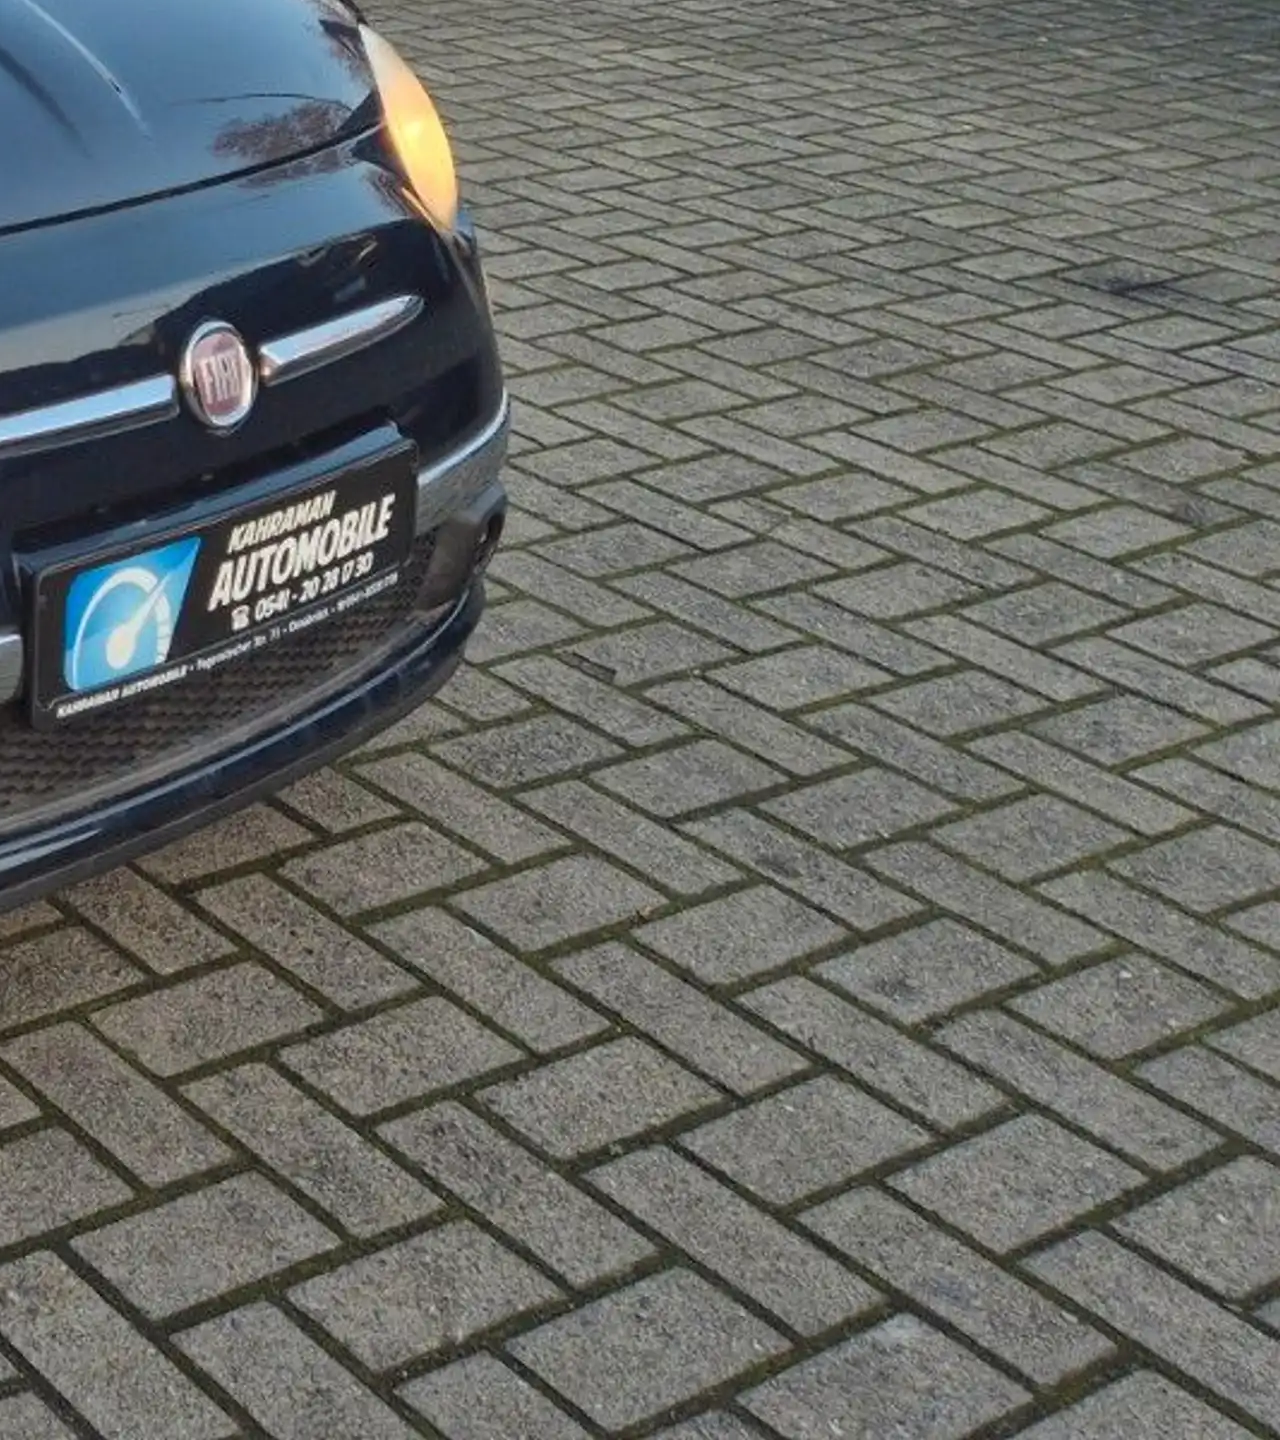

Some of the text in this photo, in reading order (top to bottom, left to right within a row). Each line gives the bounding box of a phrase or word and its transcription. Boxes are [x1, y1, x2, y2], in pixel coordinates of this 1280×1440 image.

[207, 493, 397, 612] AUTOMOBILE
[227, 490, 338, 555] KAHRAMAN
[254, 589, 291, 622] 0541
[298, 576, 321, 603] 20
